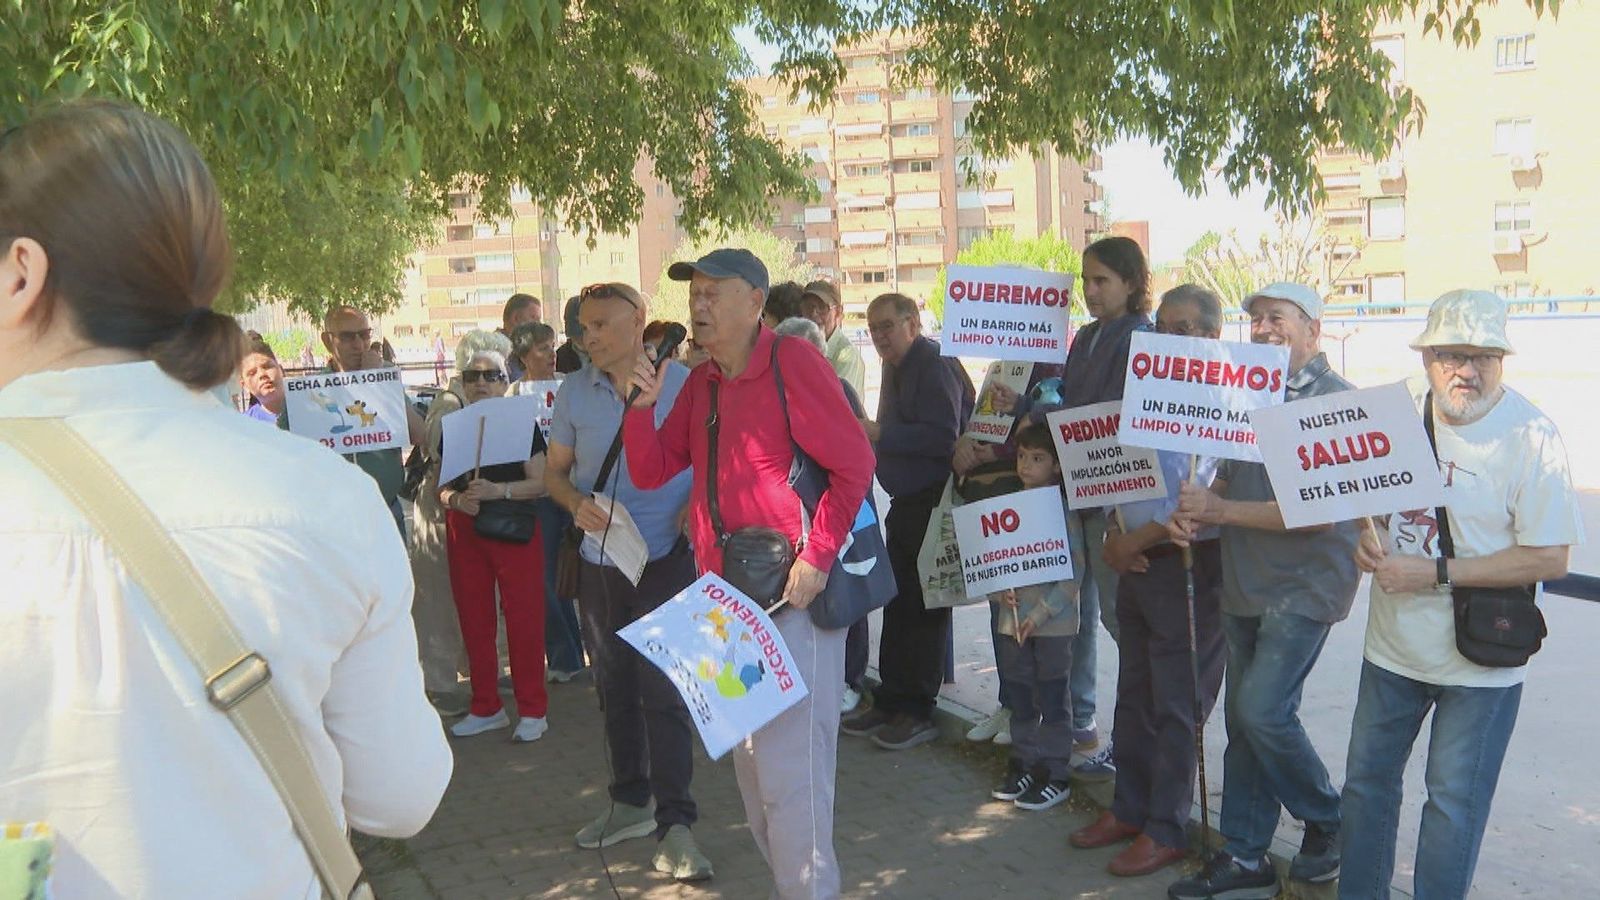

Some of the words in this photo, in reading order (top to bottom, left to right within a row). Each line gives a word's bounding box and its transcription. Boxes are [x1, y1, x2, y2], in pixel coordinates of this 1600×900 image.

[949, 280, 1069, 307] QUEREMOS
[960, 318, 977, 328] UN
[981, 320, 1025, 331] BARRIO
[1028, 321, 1051, 333] MÁS
[952, 332, 994, 345] LIMPIO
[997, 335, 1005, 346] Y
[1007, 336, 1058, 349] SALUBRE
[287, 379, 321, 391] ECHA
[324, 374, 359, 388] AGUA
[362, 371, 399, 383] SOBRE
[1131, 352, 1281, 393] QUEREMOS
[1142, 398, 1163, 413] UN
[1166, 401, 1222, 421] BARRIO
[1299, 406, 1368, 431] NUESTRA
[342, 431, 392, 446] ORINES
[1059, 413, 1120, 444] PEDIM
[1131, 416, 1181, 435] LIMPIO
[1185, 423, 1194, 436] Y
[1198, 426, 1257, 444] SALUBR
[1087, 446, 1123, 461] MAYOR
[1297, 431, 1391, 471] SALUD
[1071, 459, 1131, 480] IMPLICACIÓN
[1132, 459, 1152, 471] DEL
[1076, 475, 1156, 498] AYUNTAMIENTO
[1299, 481, 1335, 502] ESTÁ
[1337, 480, 1360, 494] EN
[1362, 471, 1413, 492] JUEGO
[981, 508, 1020, 538] NO
[964, 558, 971, 569] A
[971, 554, 982, 567] LA
[983, 539, 1065, 563] DEGRADACIÓN
[966, 572, 977, 583] DE
[978, 562, 1019, 580] NUESTRO
[1022, 555, 1068, 571] BARRIO
[702, 583, 794, 693] EXCREMENTOS
